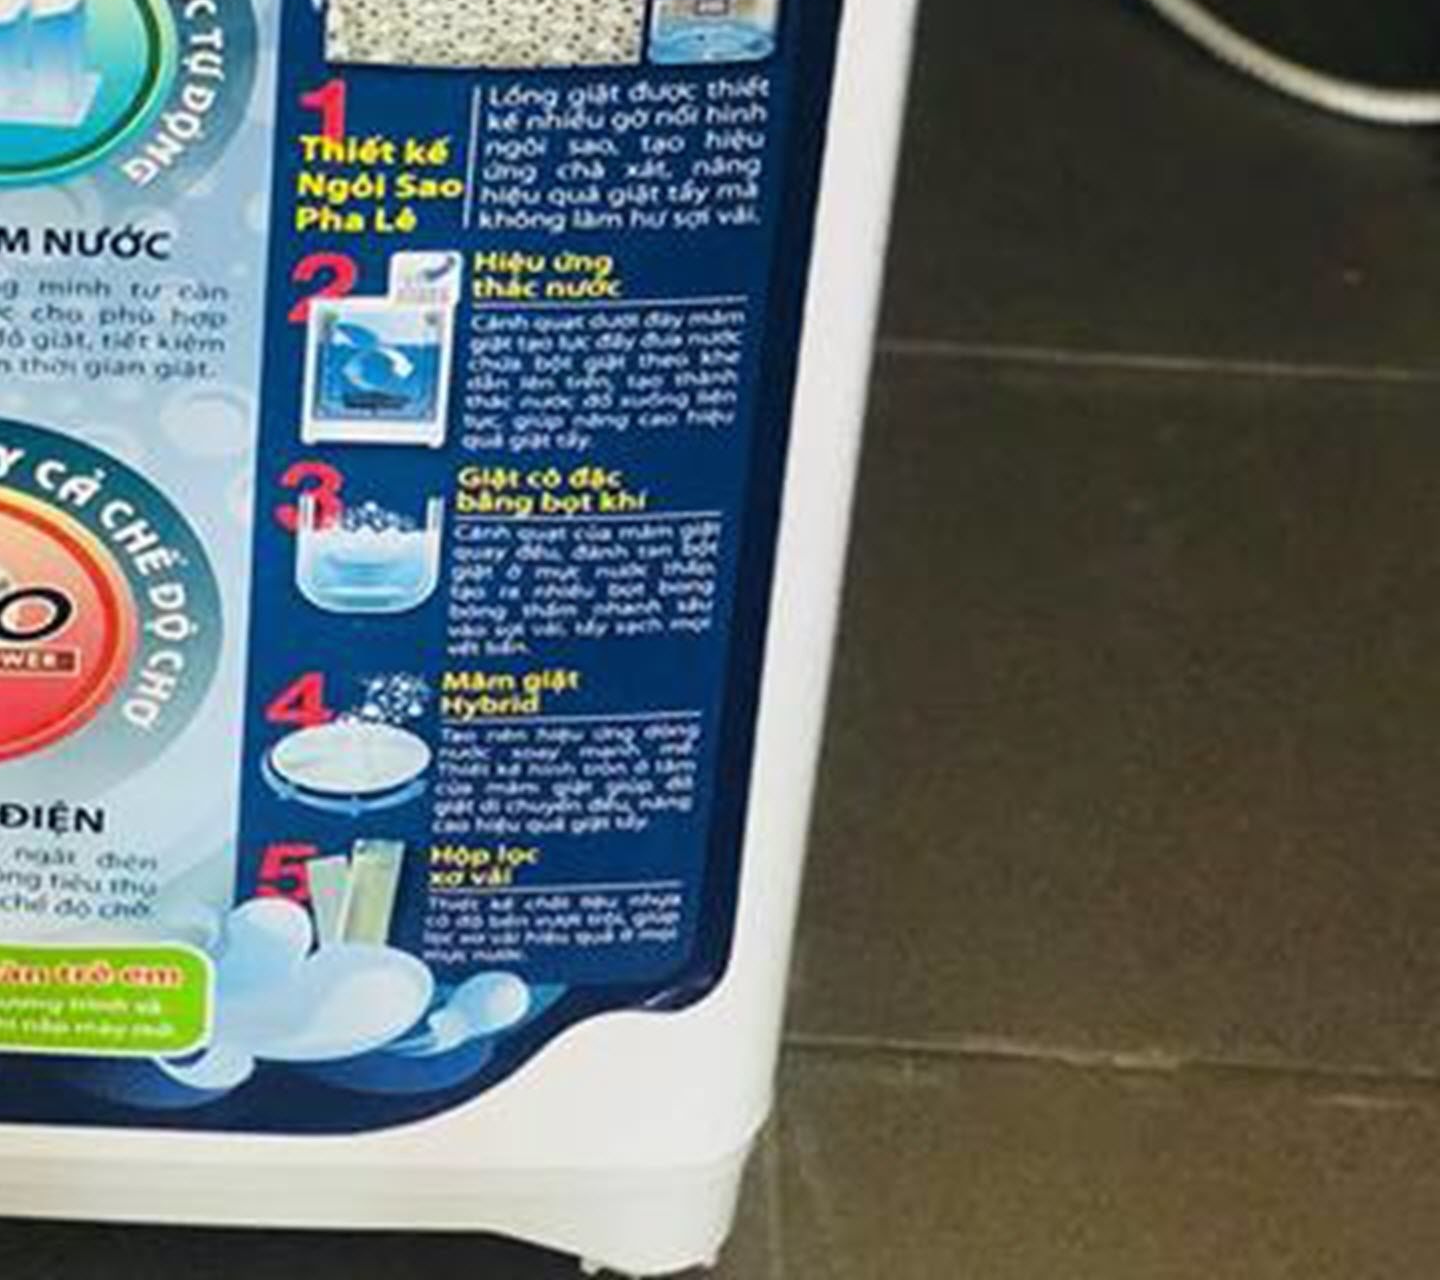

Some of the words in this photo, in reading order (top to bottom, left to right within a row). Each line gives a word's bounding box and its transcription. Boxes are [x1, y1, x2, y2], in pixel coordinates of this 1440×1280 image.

[299, 78, 346, 142] 1
[299, 134, 396, 163] Thiết
[404, 133, 453, 163] kế
[296, 171, 386, 204] Ngôi
[395, 173, 464, 199] Sao
[295, 205, 365, 233] Pha
[375, 204, 418, 233] Lê
[43, 224, 172, 261] NƯỚC
[473, 251, 546, 276] Hiệu
[287, 251, 358, 324] 2
[545, 276, 624, 299] nước
[457, 466, 520, 490] Giặt
[274, 460, 344, 532] 3
[599, 489, 648, 512] khí
[34, 459, 107, 507] CẢ
[99, 499, 190, 576] CHẾ
[263, 670, 334, 728] 4
[440, 694, 542, 722] Hybrid
[258, 842, 319, 904] 5
